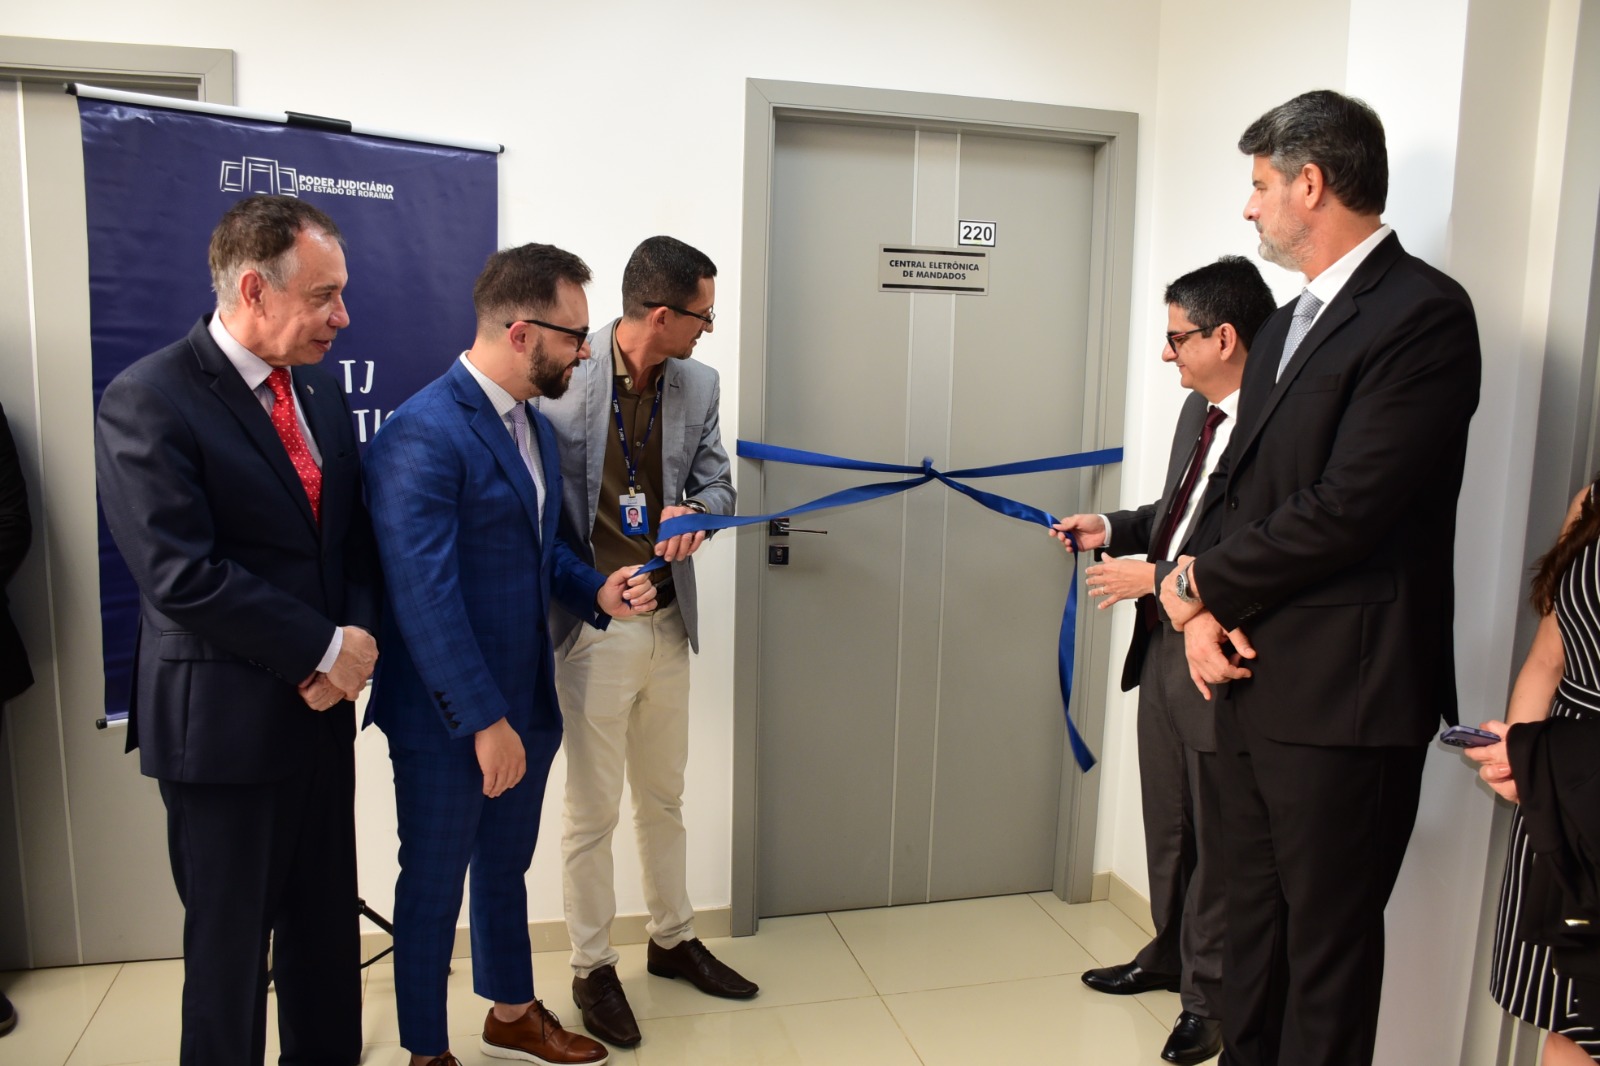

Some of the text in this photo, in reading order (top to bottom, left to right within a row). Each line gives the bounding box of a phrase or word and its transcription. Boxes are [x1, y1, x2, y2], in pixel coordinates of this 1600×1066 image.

[299, 175, 394, 193] PODER JUDICIÁRIO
[313, 185, 344, 195] ESTADO
[358, 190, 394, 200] RORAIMA
[963, 225, 992, 241] 220
[889, 260, 979, 271] CENTRAL ELETRÔNICA
[902, 270, 966, 280] DE MANDADOS
[339, 360, 375, 394] TJ
[352, 408, 395, 443] TI
